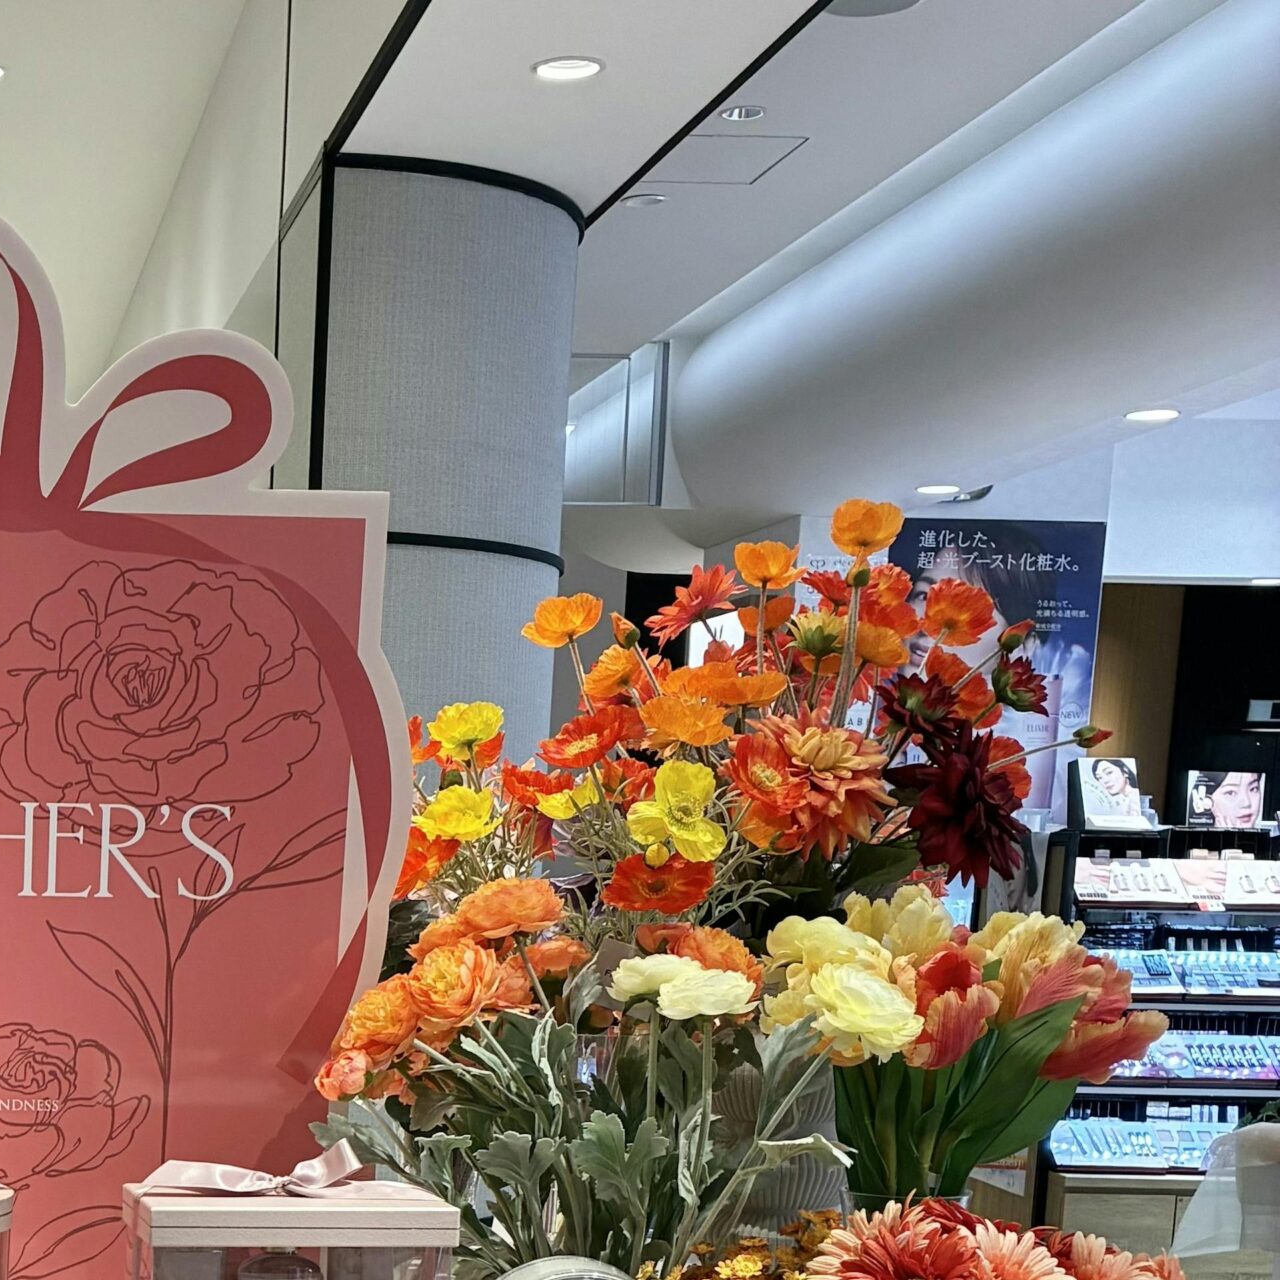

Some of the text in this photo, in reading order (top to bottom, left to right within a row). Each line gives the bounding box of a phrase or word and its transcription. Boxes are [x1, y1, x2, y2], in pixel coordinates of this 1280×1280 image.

[918, 530, 996, 548] 進化した、
[1060, 711, 1080, 719] NEW
